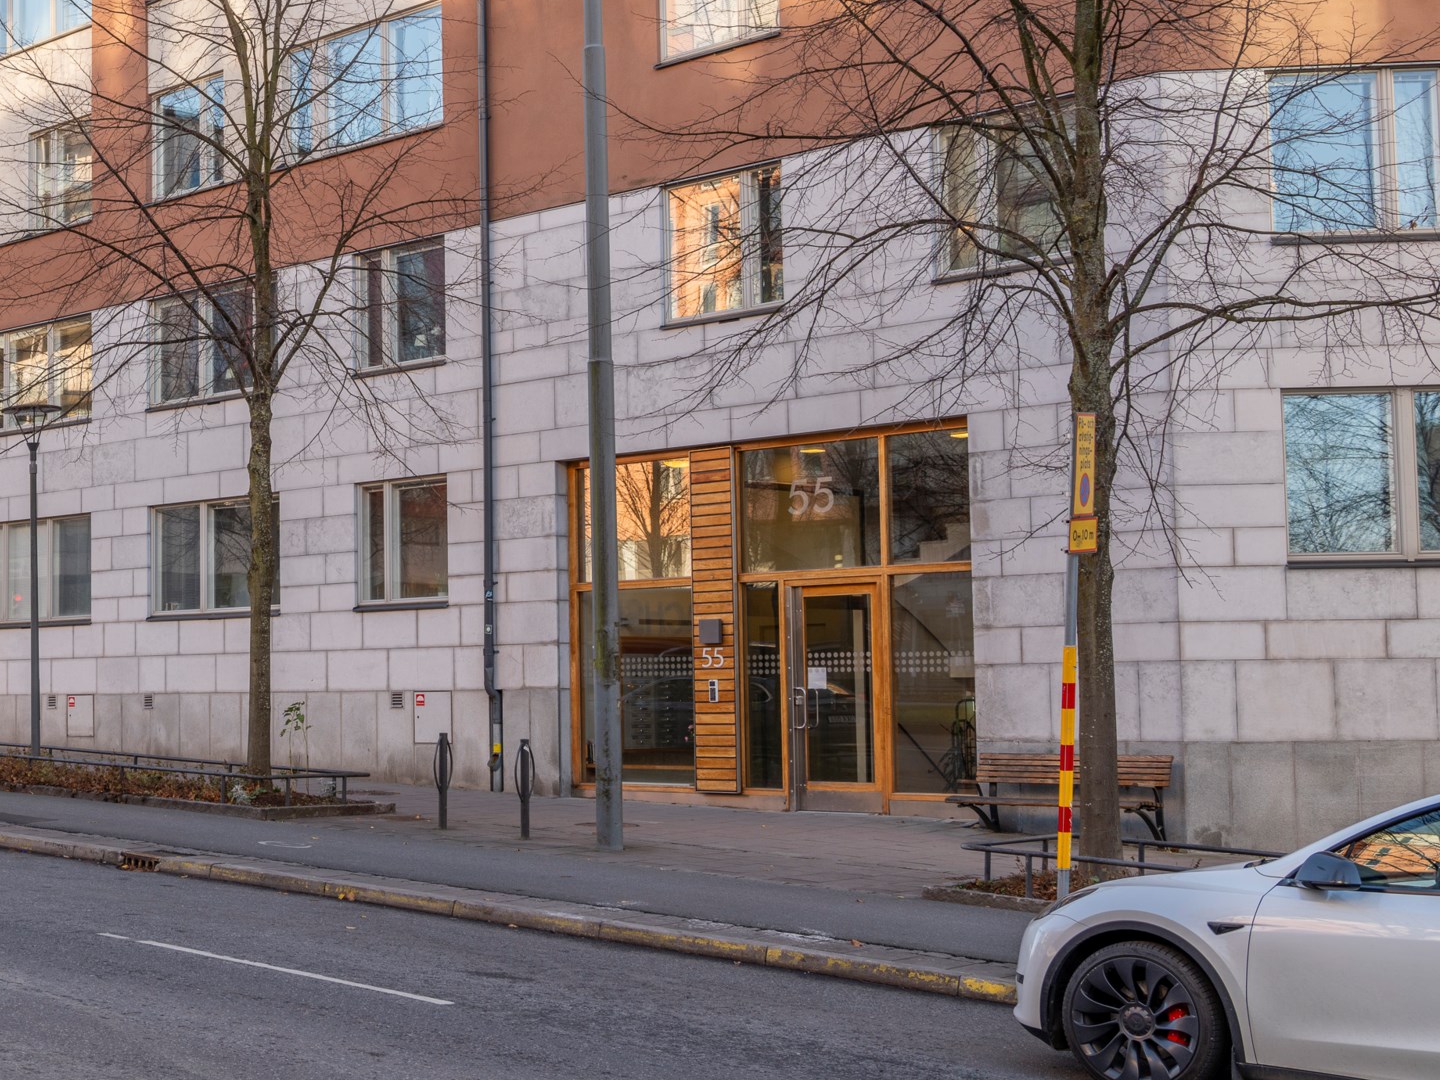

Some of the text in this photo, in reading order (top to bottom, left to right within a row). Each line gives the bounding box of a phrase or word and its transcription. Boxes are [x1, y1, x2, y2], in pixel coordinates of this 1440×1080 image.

[1079, 458, 1091, 472] plats
[787, 476, 835, 516] 55
[1088, 531, 1095, 540] m
[701, 647, 725, 669] 55
